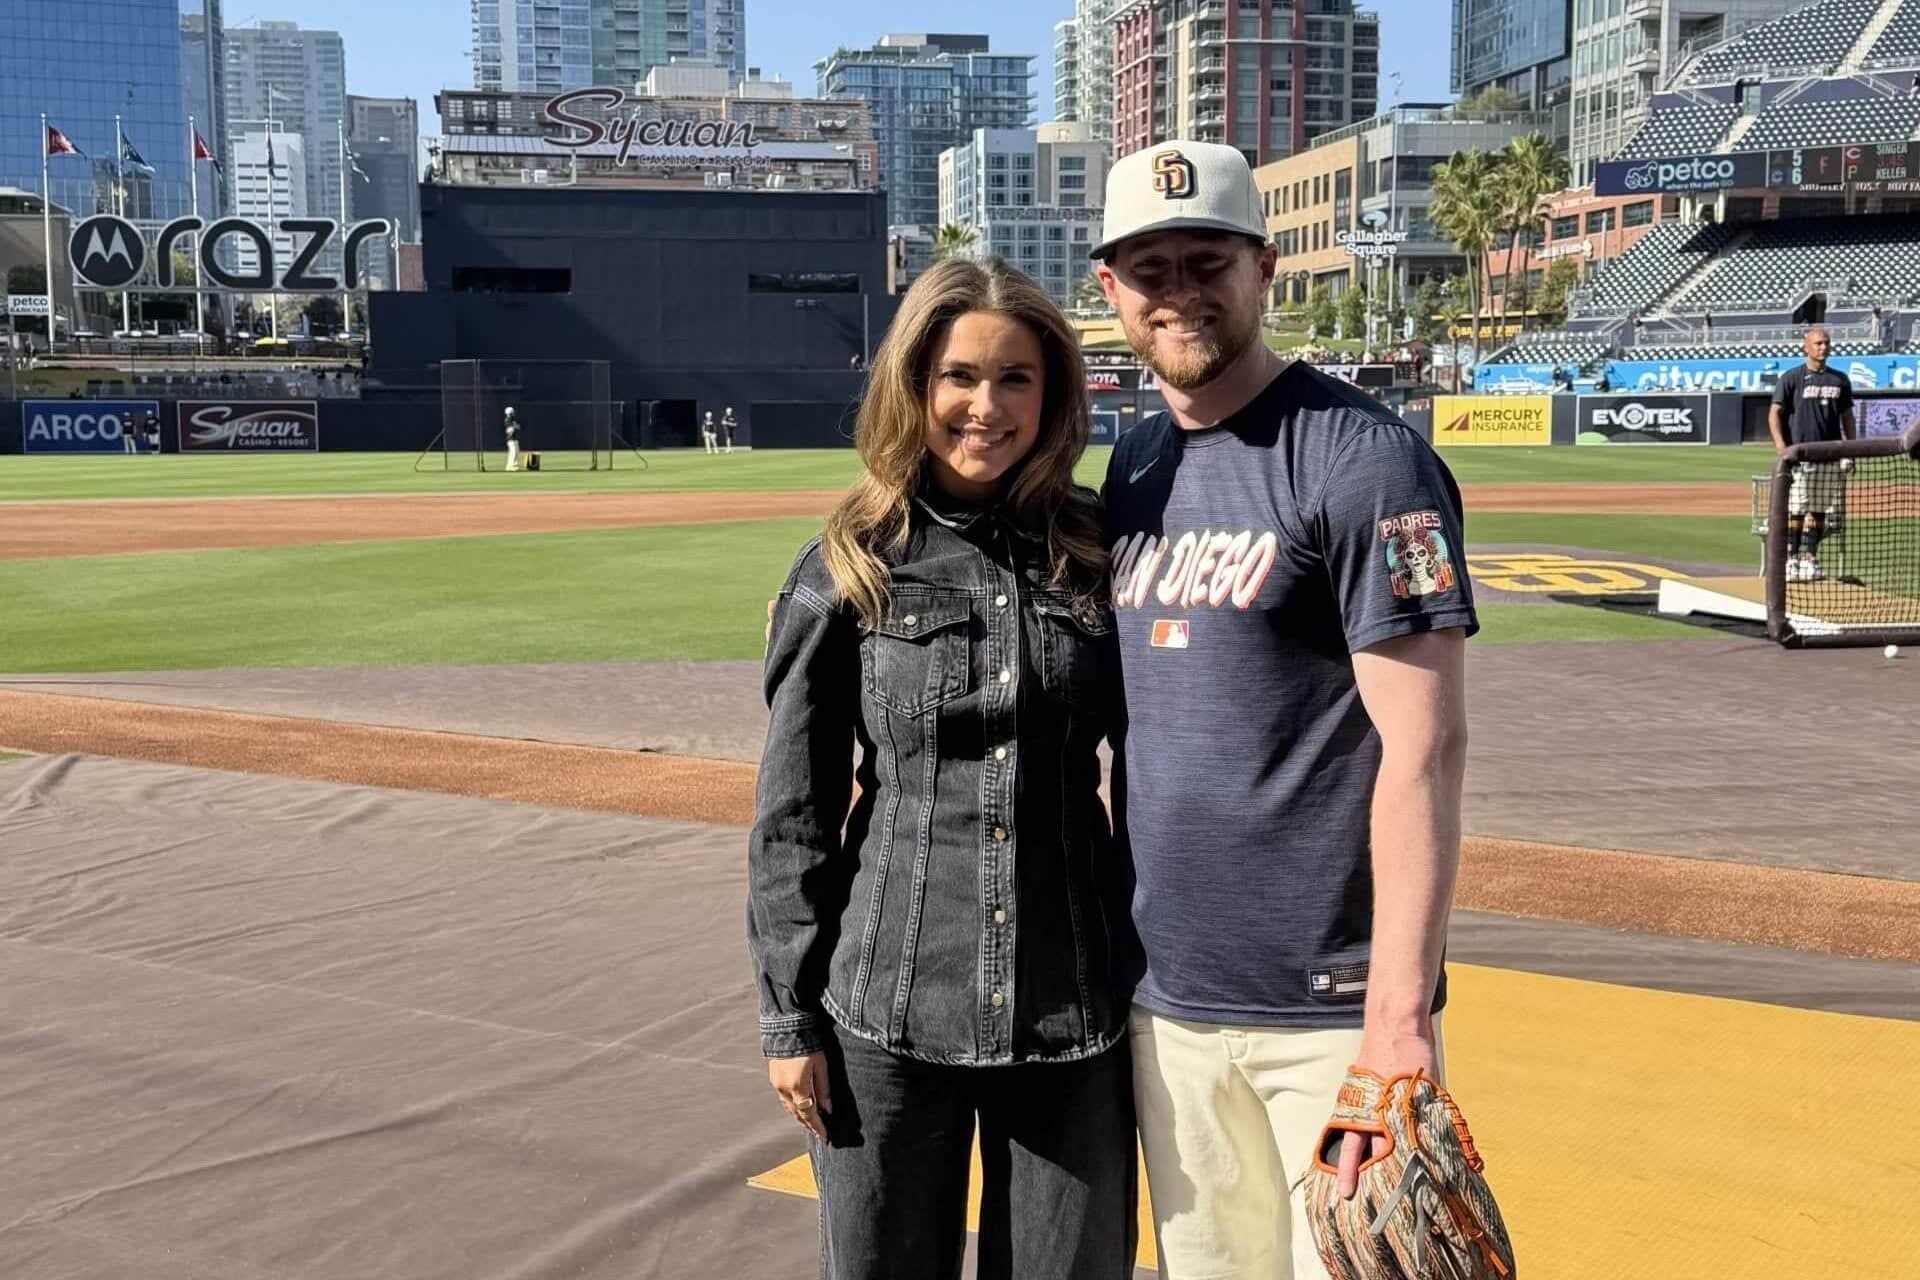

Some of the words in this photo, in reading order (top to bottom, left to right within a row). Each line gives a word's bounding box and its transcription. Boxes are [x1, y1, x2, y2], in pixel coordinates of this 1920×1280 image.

[544, 87, 760, 166] Sycuan
[639, 155, 697, 166] CASINO
[714, 155, 771, 166] RESORT
[1792, 149, 1802, 166] 5
[1152, 149, 1199, 200] SD
[1658, 158, 1735, 188] petco
[1792, 168, 1802, 184] 6
[1876, 166, 1907, 179] KELLER
[1335, 230, 1408, 244] Gallagher
[156, 217, 391, 289] razr
[1346, 243, 1397, 258] Square
[1089, 373, 1120, 384] OTA
[1472, 409, 1543, 421] MERCURY
[1592, 403, 1693, 430] EVOTEK
[29, 414, 122, 440] ARCO
[190, 406, 304, 448] Sycuan
[1472, 421, 1543, 431] INSURANCE
[239, 438, 271, 446] CASINO
[278, 438, 309, 446] RESORT
[1381, 512, 1442, 538] PADRES
[1110, 531, 1169, 609] AN
[1157, 528, 1277, 610] DIEGO
